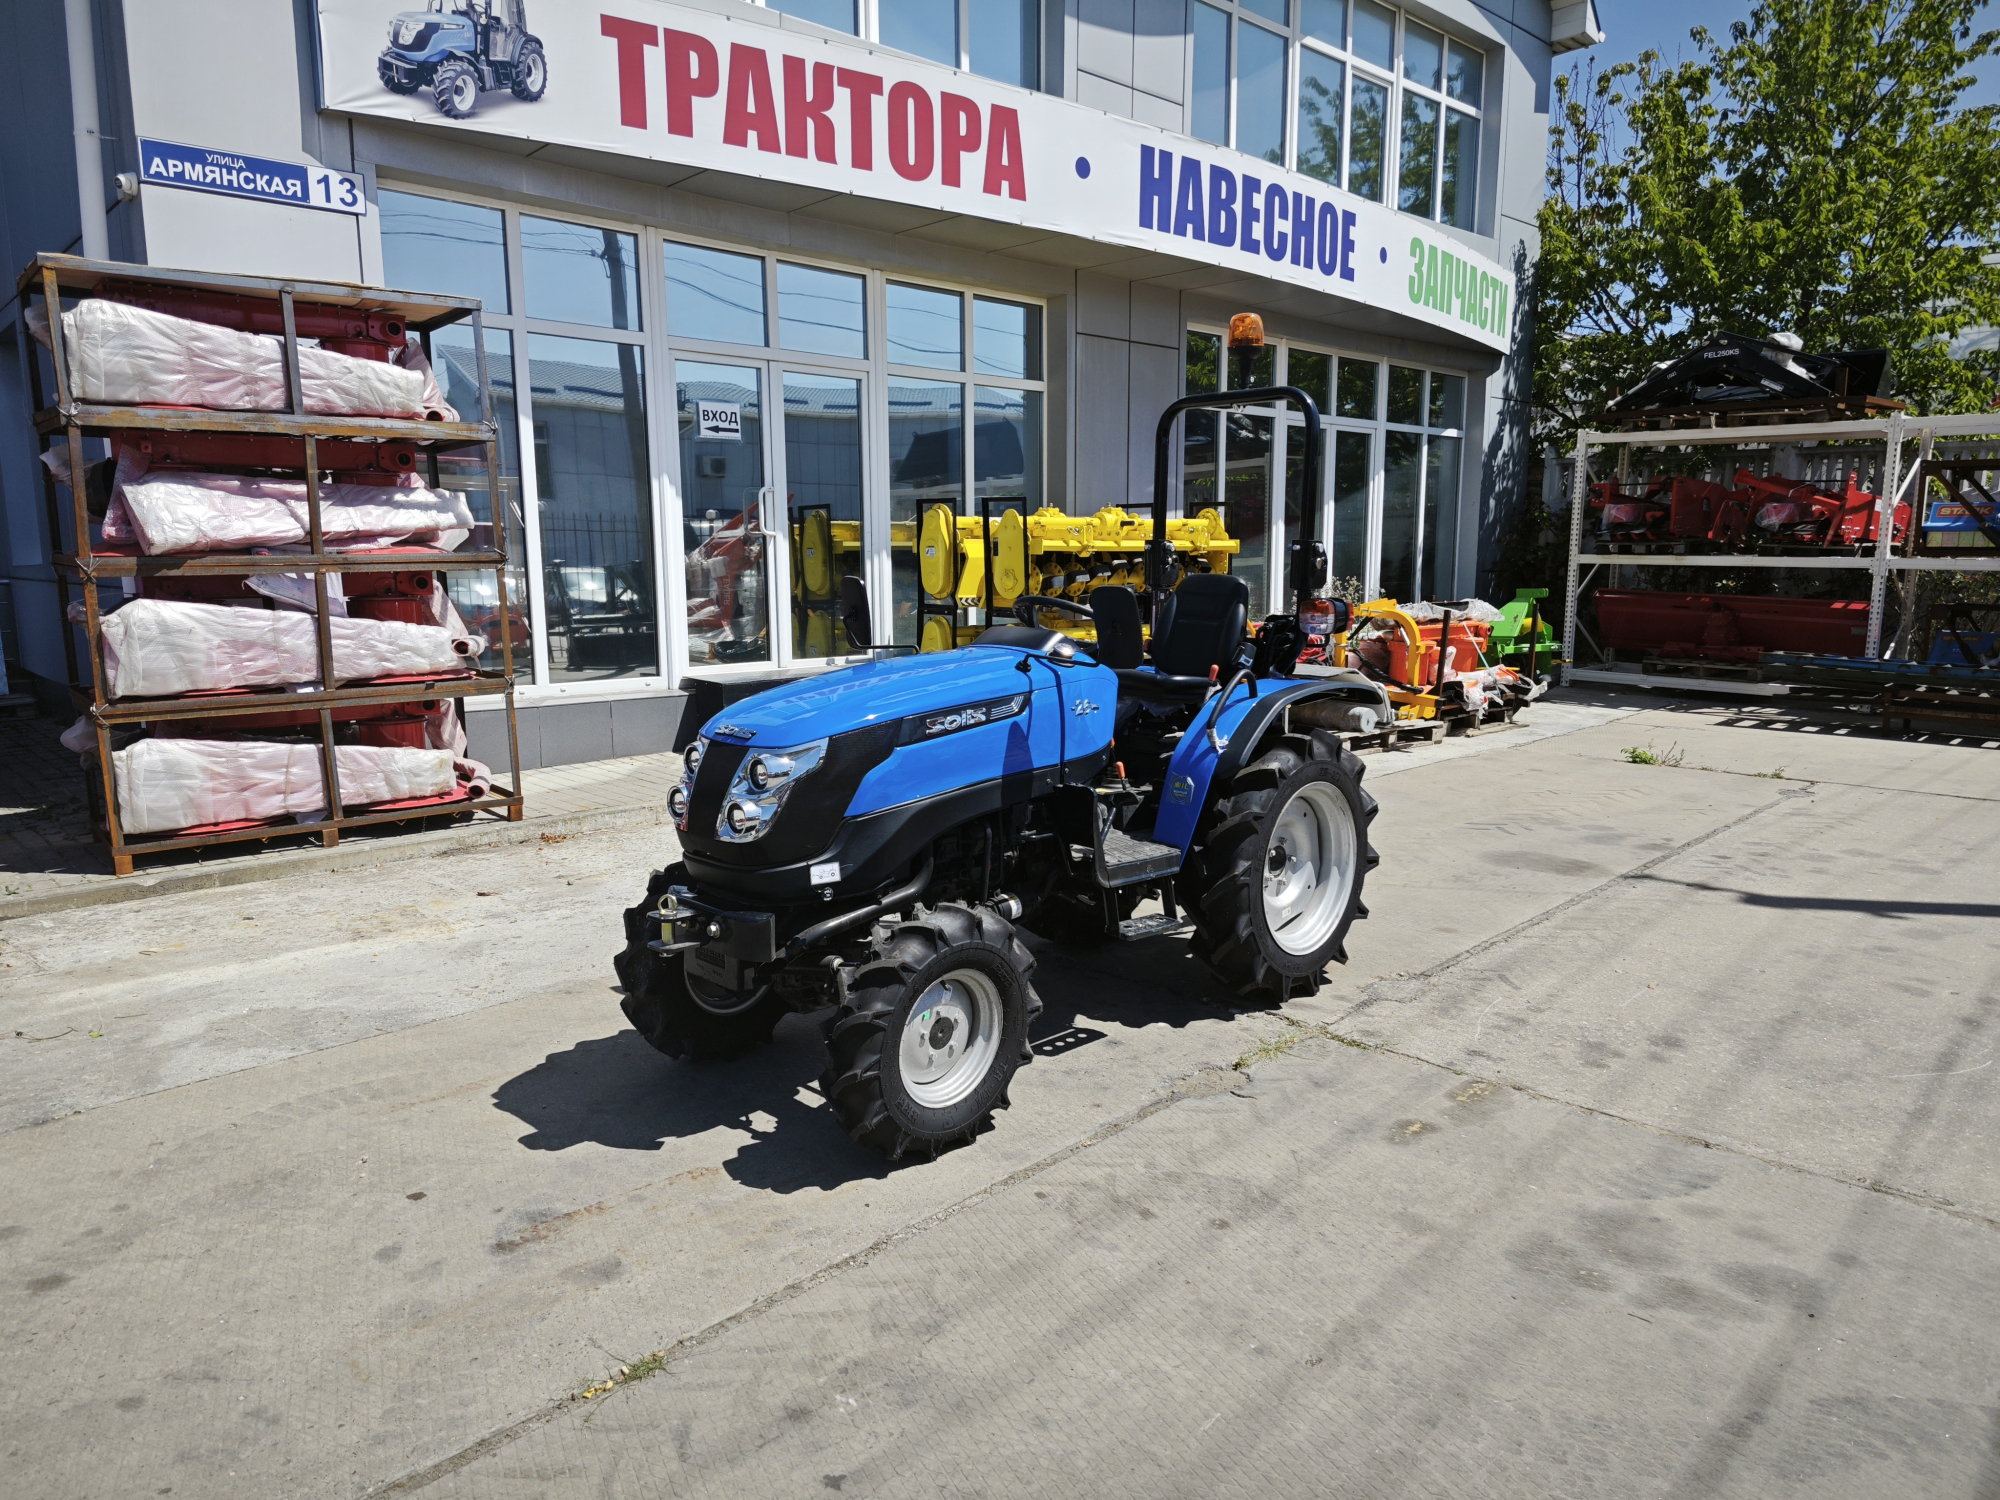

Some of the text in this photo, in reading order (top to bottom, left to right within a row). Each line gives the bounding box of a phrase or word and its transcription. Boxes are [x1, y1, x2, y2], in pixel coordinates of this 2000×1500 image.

[205, 153, 246, 170] УЛИЦА
[150, 157, 359, 208] АРМЯНСКАЯ 13
[600, 13, 1509, 339] ТРАКТОРА НАВЕСНОЕ ЗАПЧАСТИ
[1703, 348, 1740, 359] FEL250KS
[702, 409, 739, 426] ВХОД
